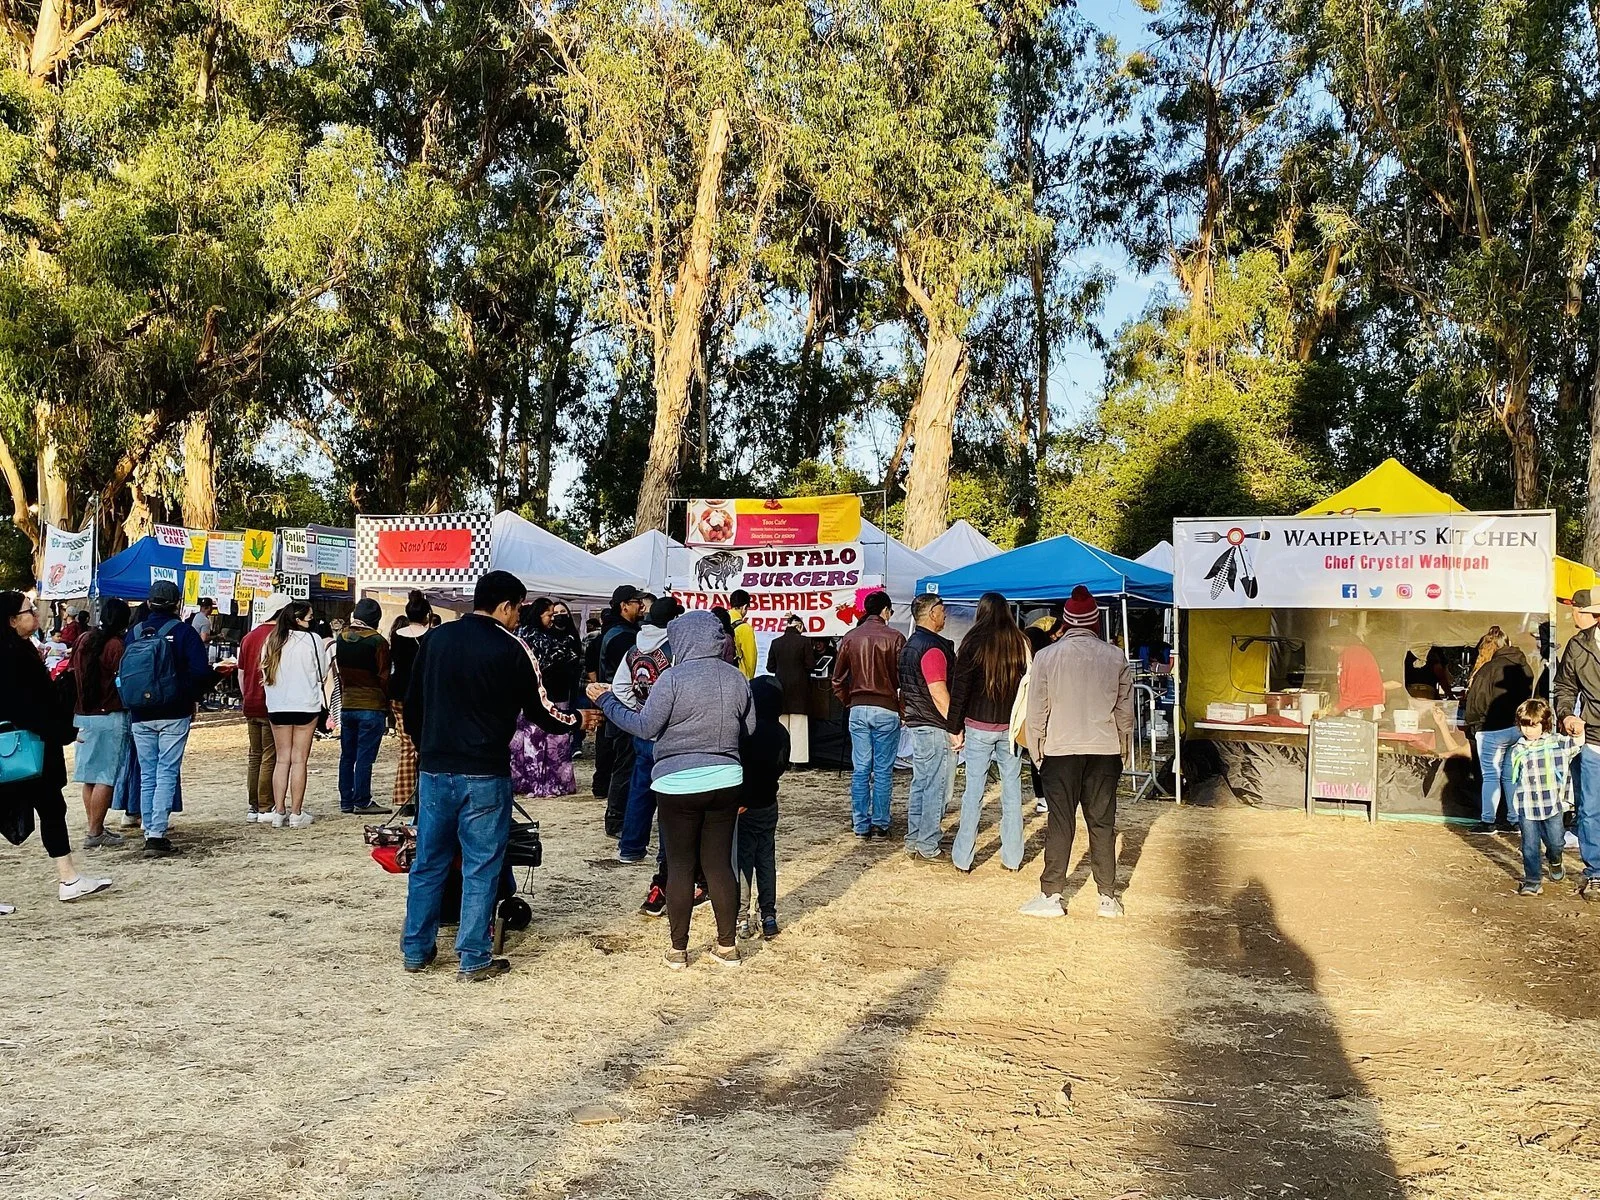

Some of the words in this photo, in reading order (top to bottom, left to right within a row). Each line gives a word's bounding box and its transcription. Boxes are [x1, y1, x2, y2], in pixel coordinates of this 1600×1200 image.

[155, 526, 189, 538] FUNNEL
[283, 530, 306, 543] Garlic
[1284, 530, 1426, 546] WAHPEPAH'S
[1436, 527, 1537, 546] KITCHEN
[163, 536, 186, 546] CAKE
[400, 540, 426, 552] Nono's
[428, 541, 448, 552] Tacos
[286, 542, 305, 554] Fries
[747, 548, 857, 568] BUFFALO
[1325, 555, 1355, 569] Chef
[1360, 555, 1413, 571] Crystal
[154, 568, 175, 580] SNOW
[278, 573, 309, 586] Garlic
[740, 570, 860, 587] BURGERS
[280, 585, 307, 597] Fries
[751, 616, 826, 633] BRED
[1317, 782, 1349, 798] THANK
[1352, 782, 1370, 798] YOU
